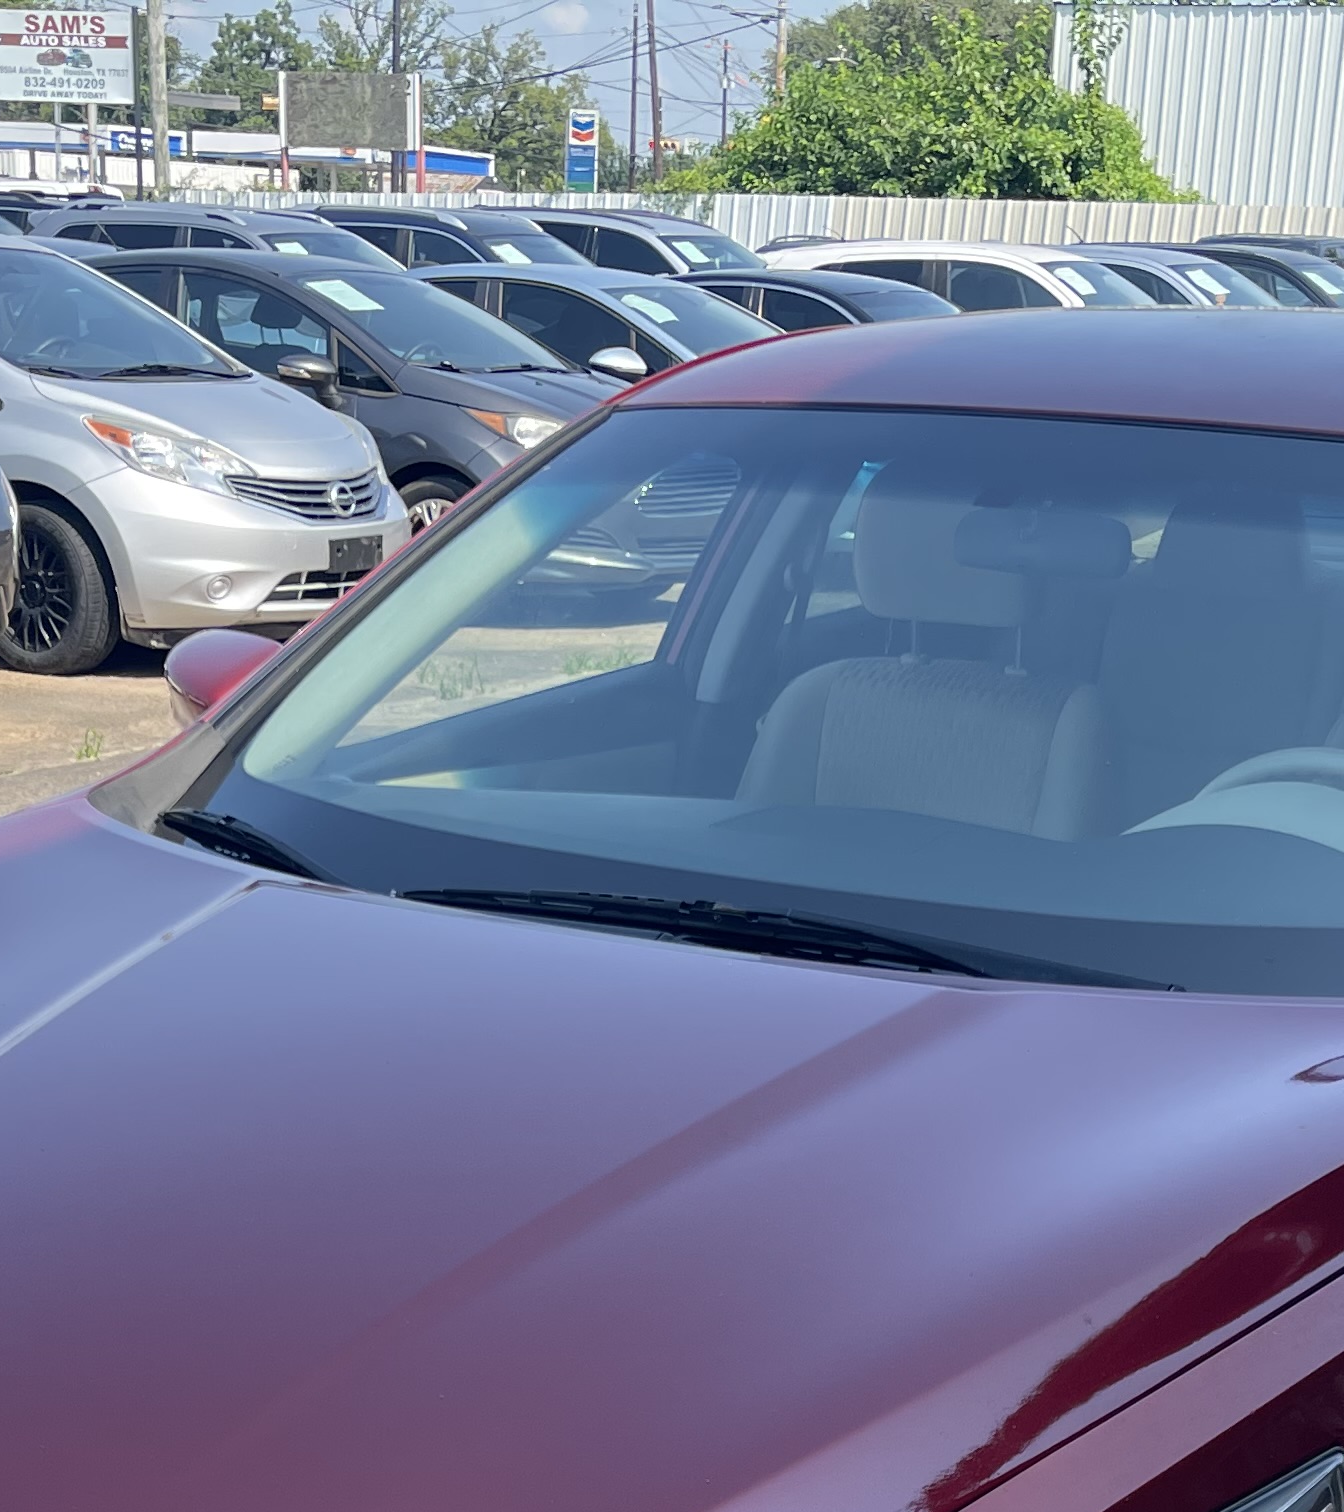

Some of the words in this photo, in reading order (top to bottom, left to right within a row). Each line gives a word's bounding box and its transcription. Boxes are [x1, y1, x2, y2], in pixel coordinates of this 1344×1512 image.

[24, 14, 106, 34] SAM'S
[20, 35, 57, 46] AUTO
[62, 36, 106, 48] SALES
[97, 69, 106, 77] TX
[24, 76, 106, 90] 832-491-0209
[23, 90, 48, 98] DRIVE
[50, 90, 74, 98] AWAY
[77, 91, 108, 99] TODAY!
